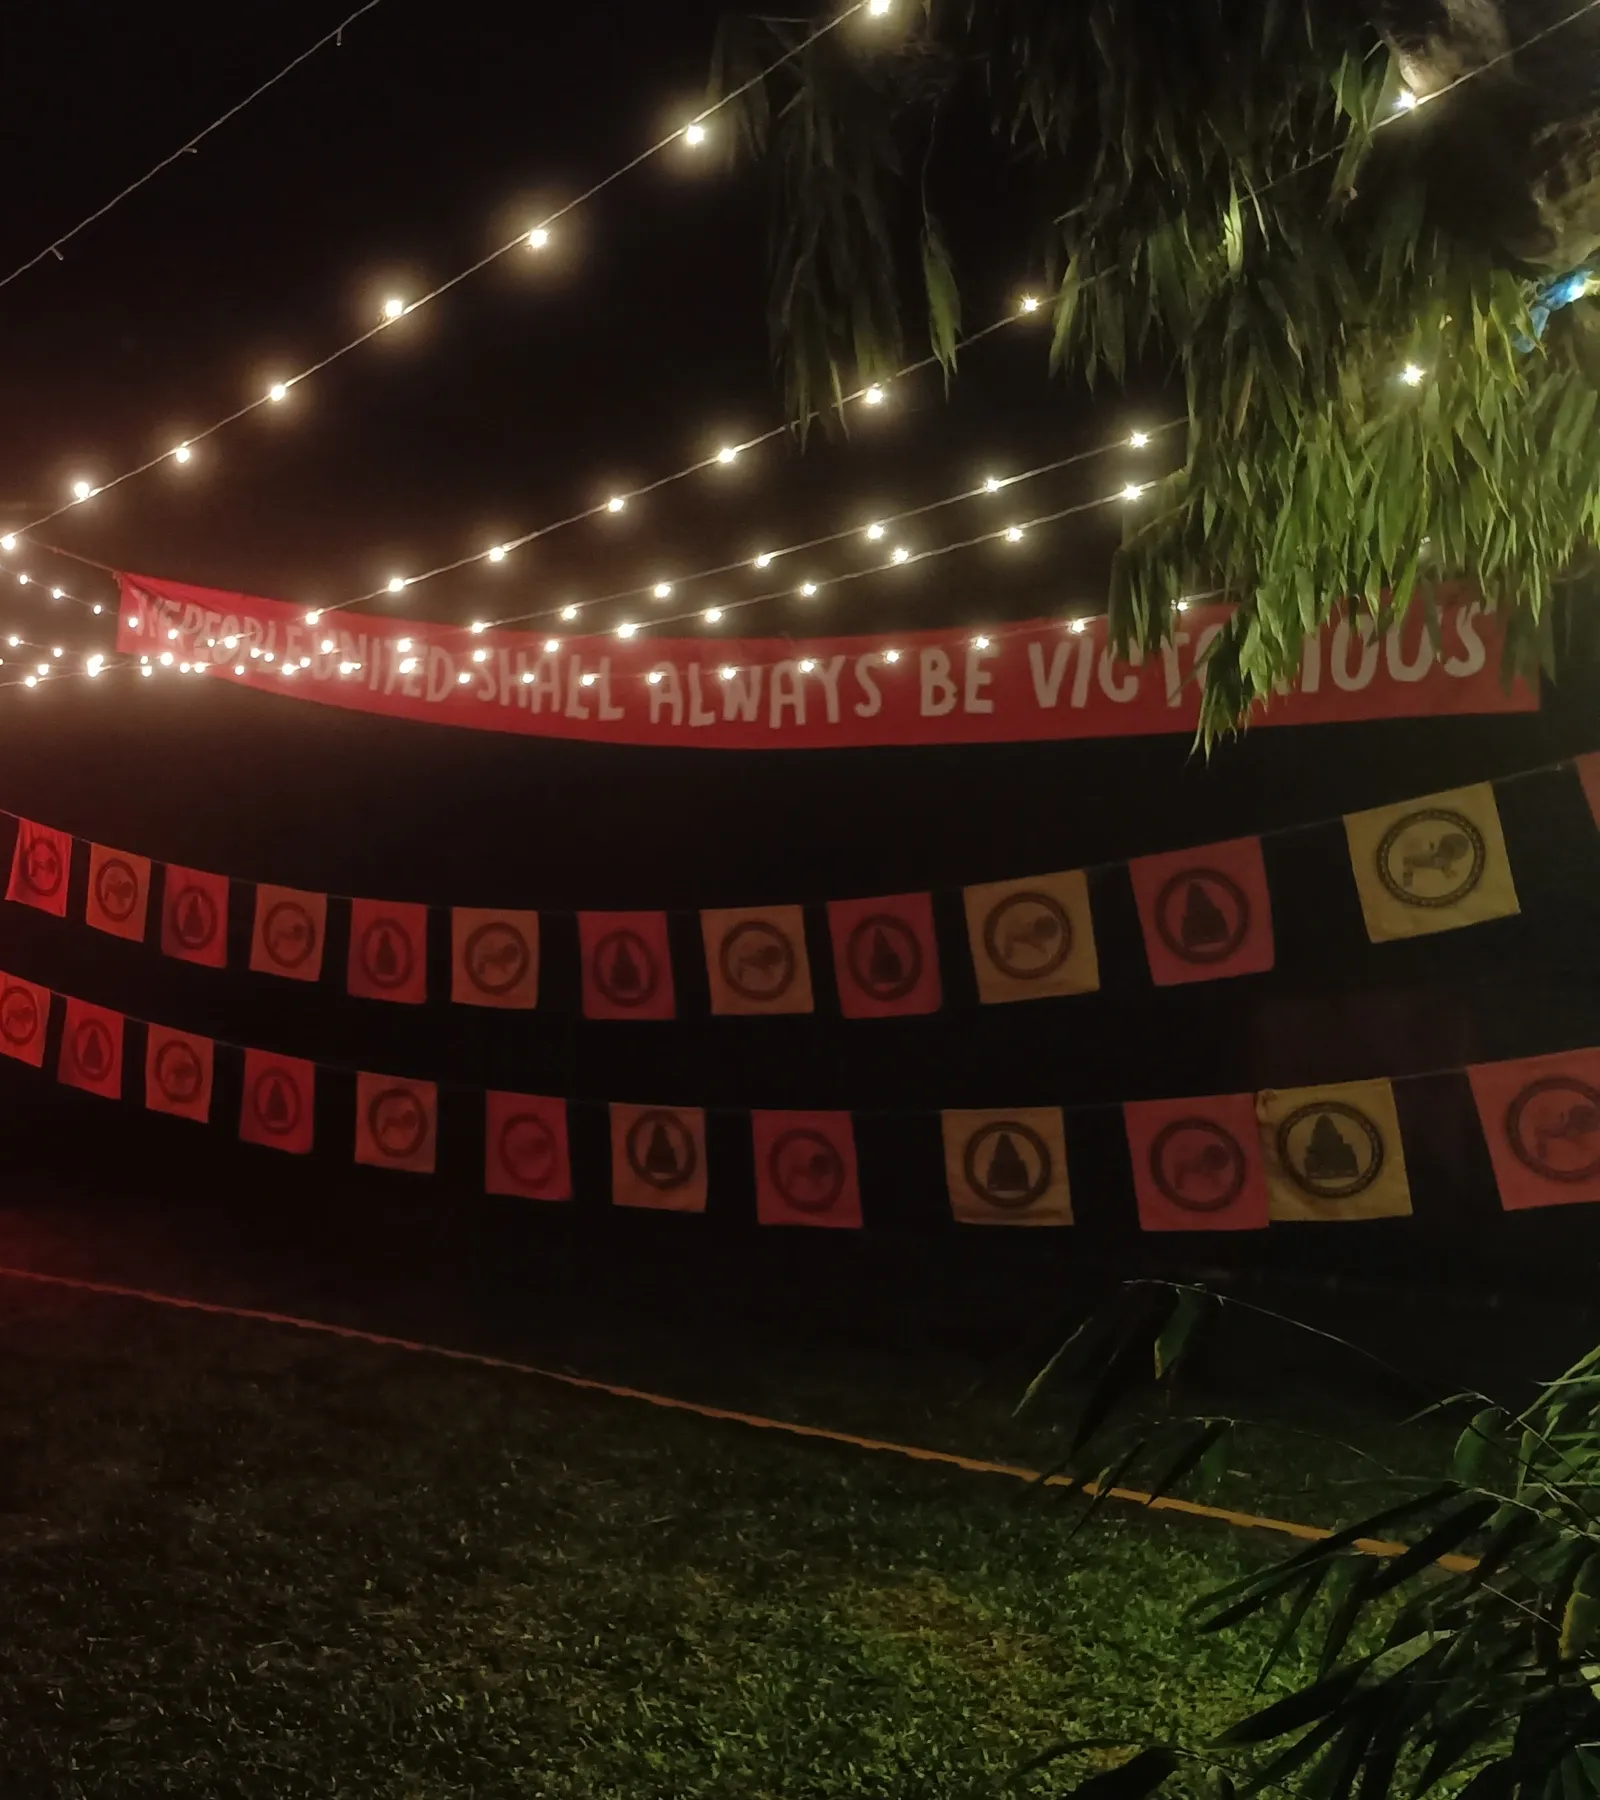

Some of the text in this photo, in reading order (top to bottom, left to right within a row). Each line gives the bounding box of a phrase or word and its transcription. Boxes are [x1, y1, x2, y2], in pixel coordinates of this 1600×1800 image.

[177, 602, 306, 678] PEOPLE
[311, 630, 454, 702] UNITED
[474, 645, 625, 721] SHALL
[649, 654, 884, 728] ALWAYS
[920, 647, 1000, 717] BE
[1028, 599, 1499, 708] VICTIOUS
